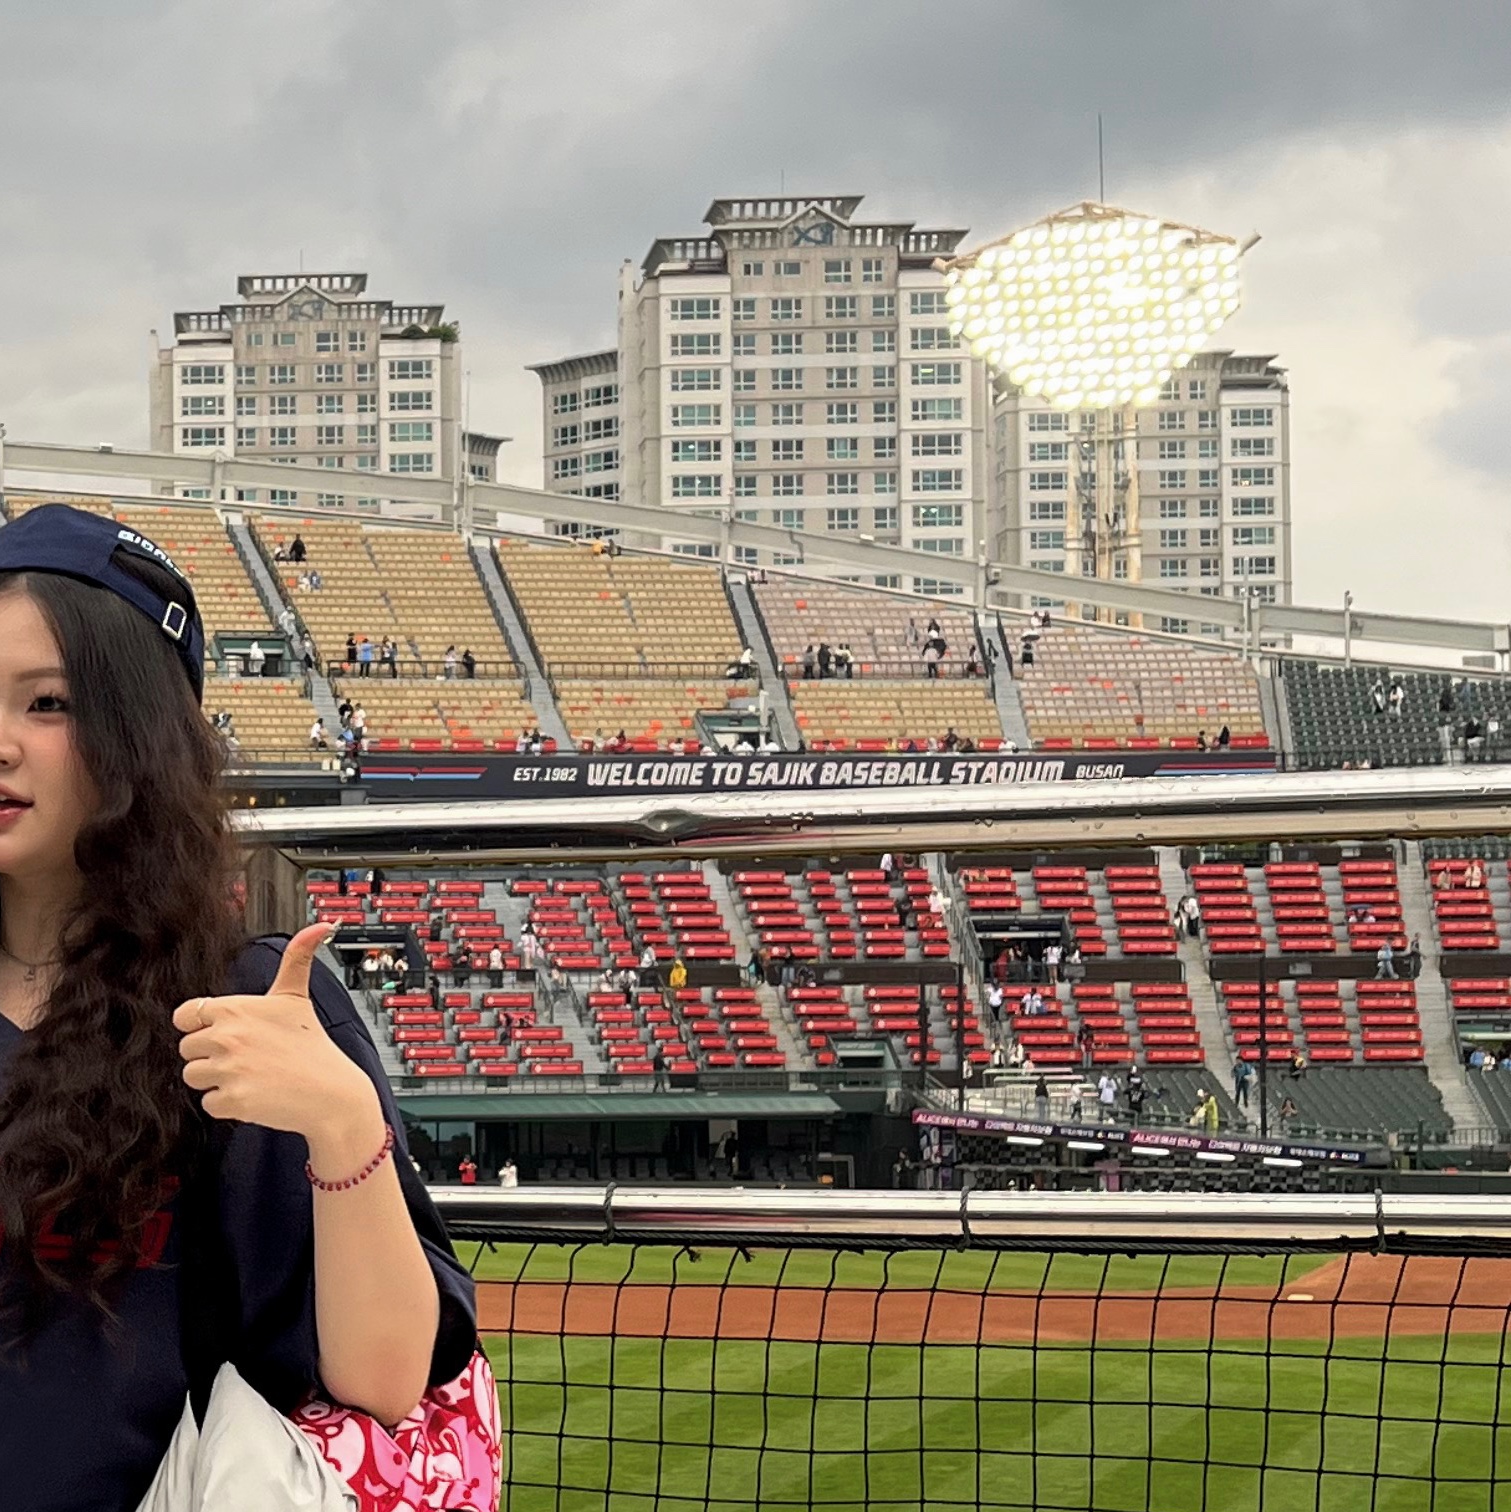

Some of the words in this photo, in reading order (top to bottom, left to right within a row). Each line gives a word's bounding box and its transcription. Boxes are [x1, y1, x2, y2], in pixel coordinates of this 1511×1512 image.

[513, 766, 579, 783] EST.1982
[586, 761, 707, 788] WELCOME
[711, 761, 743, 787] TO
[746, 761, 817, 786] SAJIK
[819, 760, 946, 786] BASEBALL
[949, 760, 1066, 785] STADIUM
[1075, 763, 1125, 780] BUSAN
